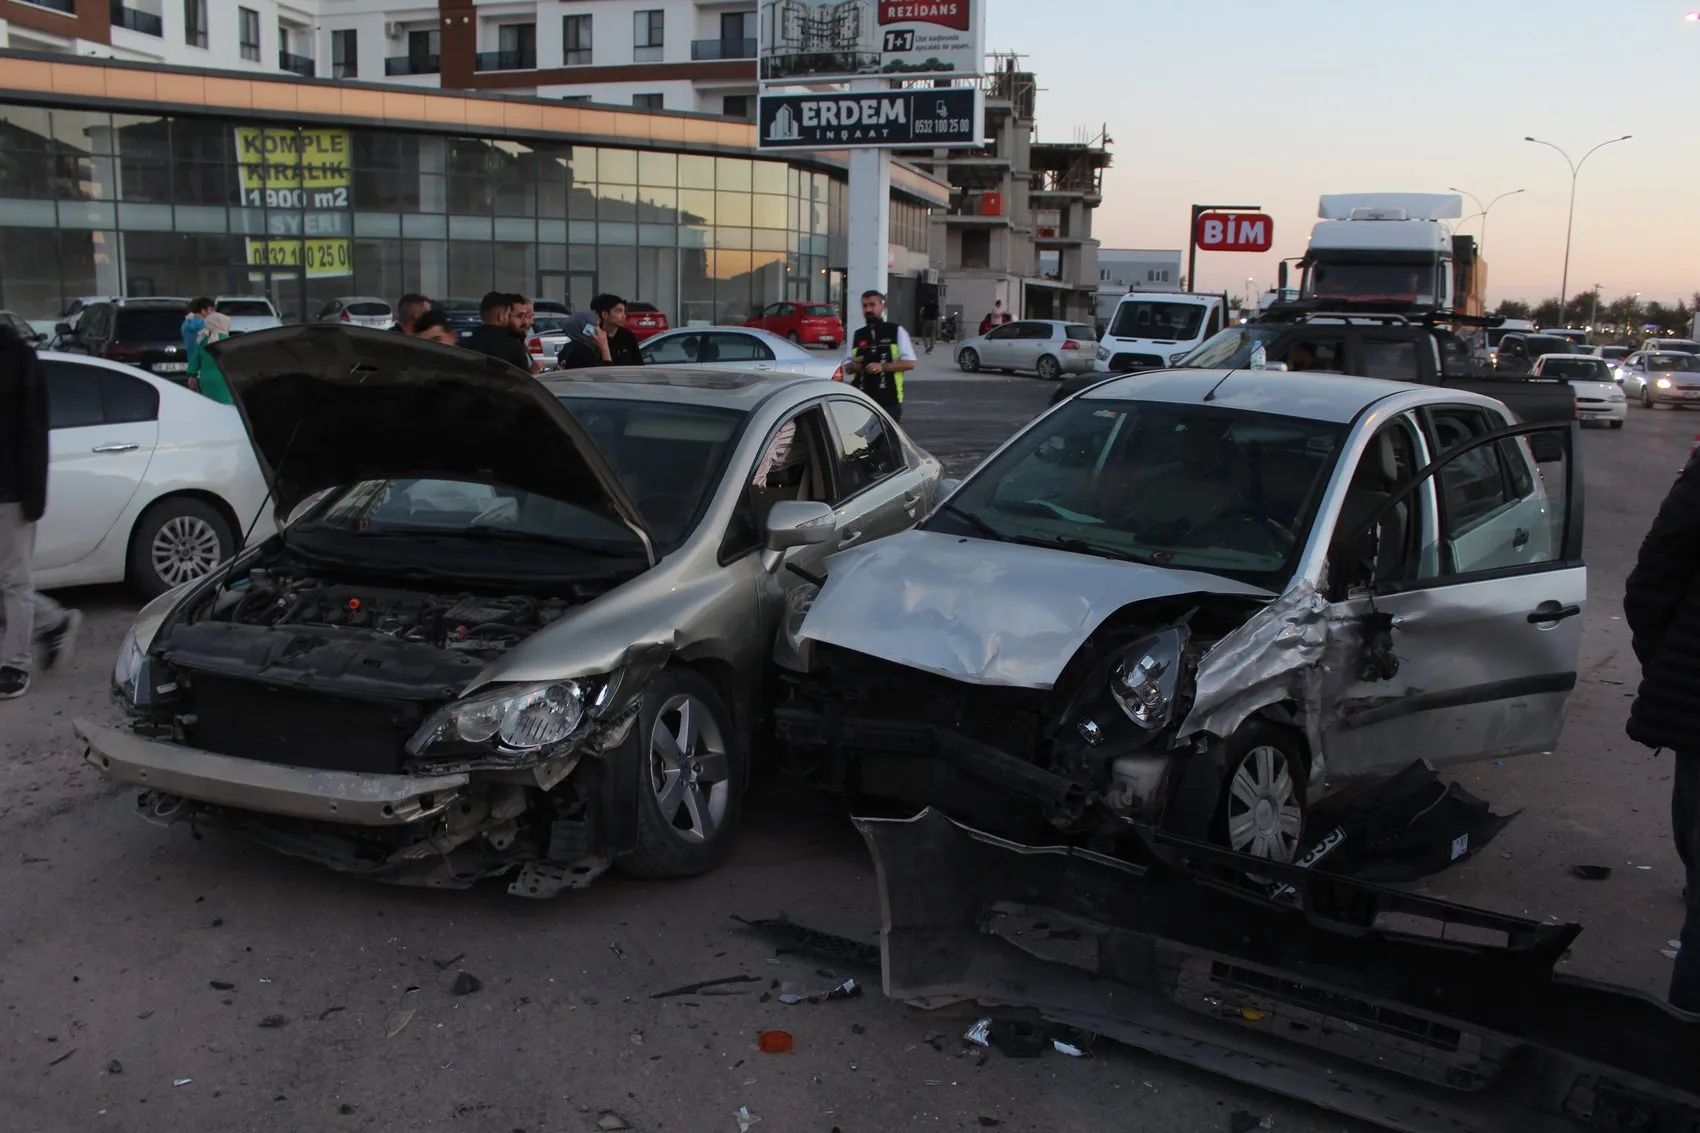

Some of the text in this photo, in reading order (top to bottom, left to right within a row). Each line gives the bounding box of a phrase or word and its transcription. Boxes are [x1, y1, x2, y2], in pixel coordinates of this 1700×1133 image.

[888, 4, 957, 17] REZİDANS
[886, 32, 913, 50] 1+1
[801, 98, 906, 126] ERDEM
[816, 128, 889, 141] İNŞAAT
[914, 118, 970, 133] 0532 100 25 00
[243, 135, 344, 154] KOMPLE
[249, 187, 348, 208] 1900 m2
[1203, 214, 1265, 245] BİM
[319, 244, 334, 267] 25
